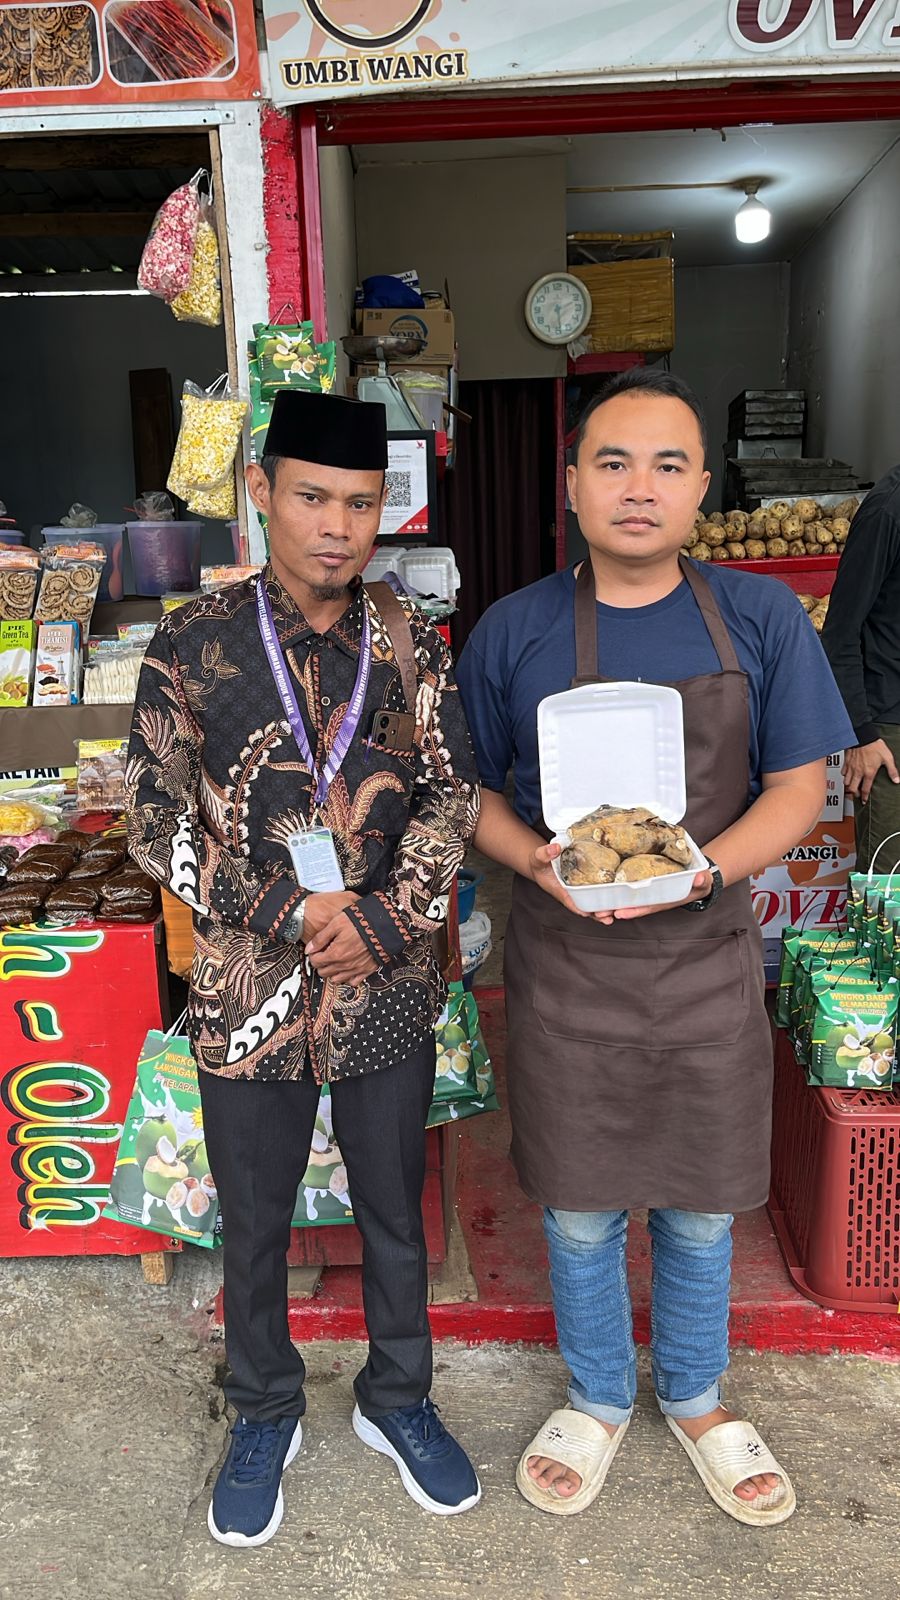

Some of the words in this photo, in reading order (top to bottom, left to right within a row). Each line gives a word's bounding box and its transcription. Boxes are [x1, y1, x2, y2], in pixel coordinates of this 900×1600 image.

[282, 58, 361, 87] UMBI
[366, 52, 466, 82] WANGI
[2, 631, 17, 639] Green
[19, 630, 28, 639] Tea
[266, 640, 281, 671] JAMINAN
[275, 669, 290, 696] PRODUK
[283, 693, 295, 715] HALAL
[351, 694, 363, 715] BADAN
[826, 794, 839, 807] KG
[782, 846, 838, 861] WANGI
[830, 992, 865, 1001] WINGKO
[866, 993, 895, 1002] BABAT
[839, 1000, 888, 1010] SEMARANG
[153, 1060, 199, 1080] LAMONGAN
[1, 1060, 124, 1231] Oleh
